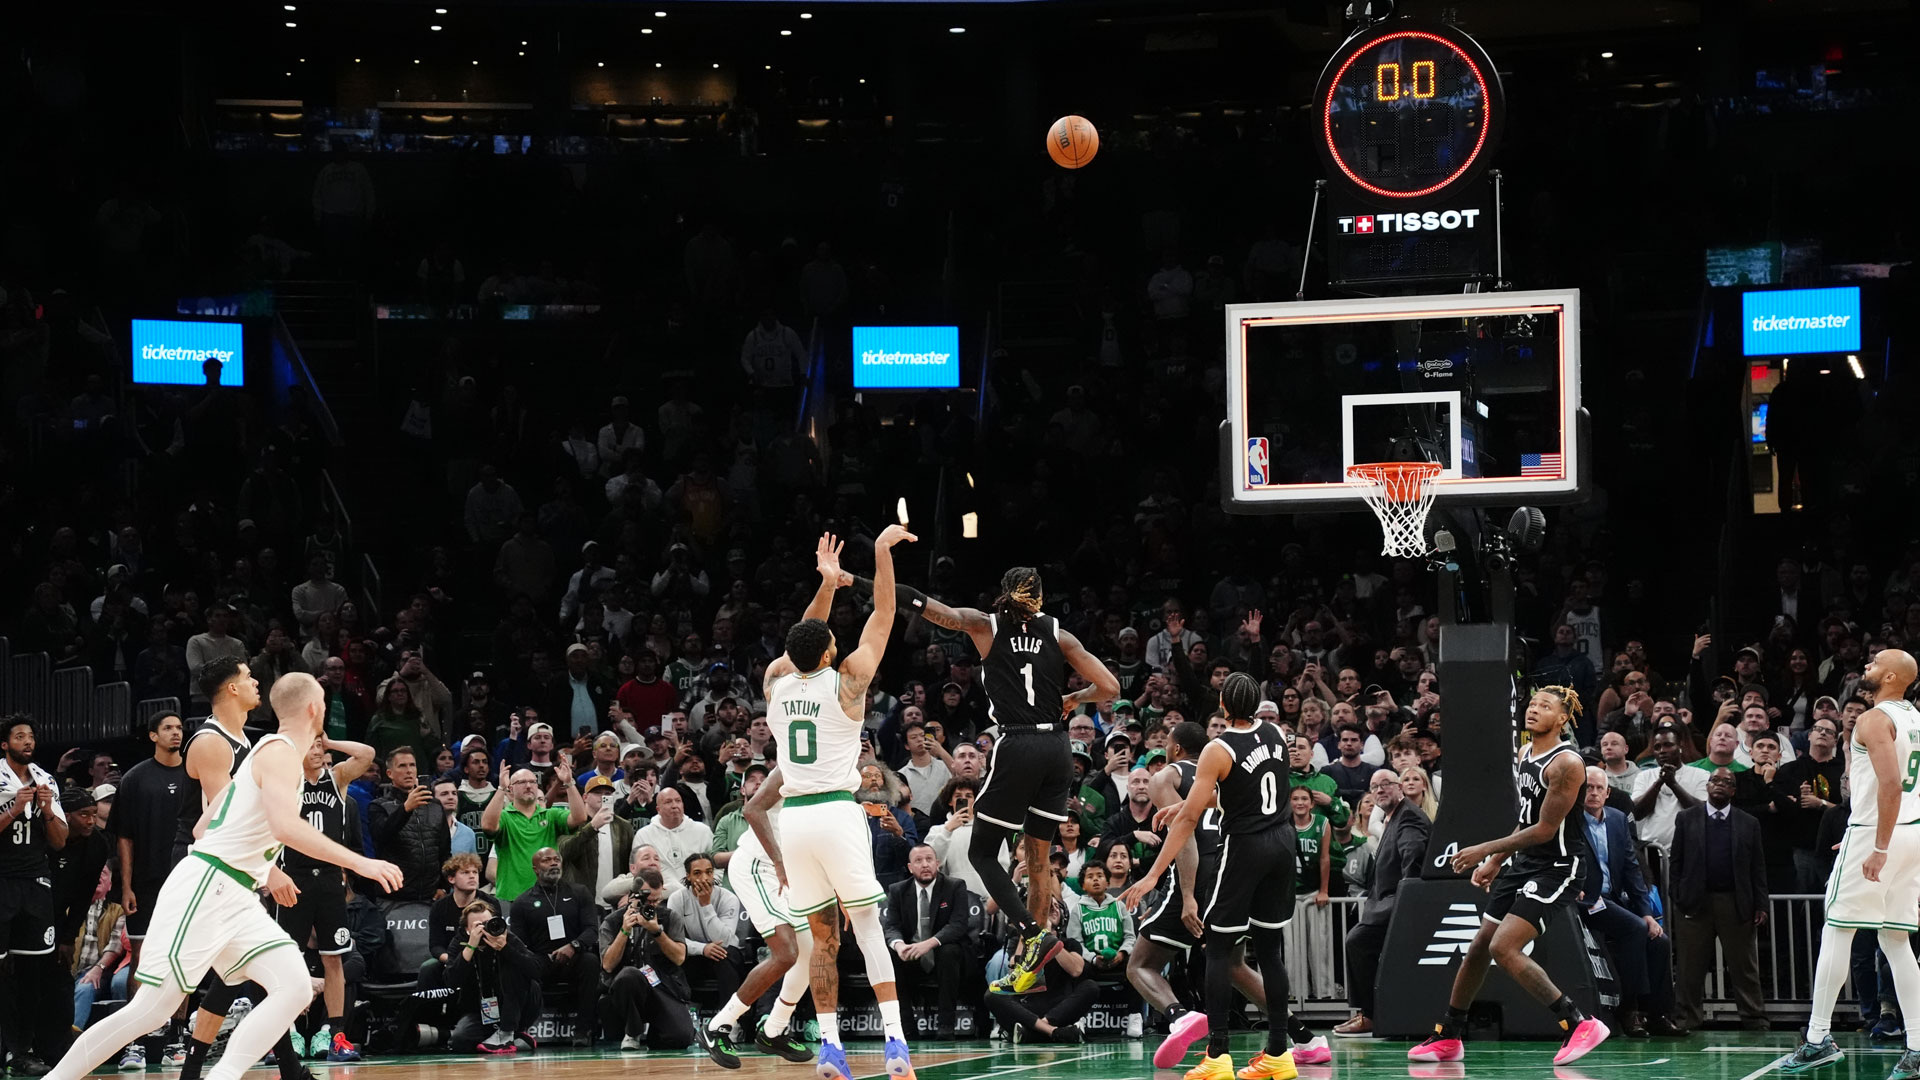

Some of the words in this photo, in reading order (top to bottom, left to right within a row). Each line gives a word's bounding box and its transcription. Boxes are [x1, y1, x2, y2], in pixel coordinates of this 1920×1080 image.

[1377, 60, 1435, 101] 0.0
[1376, 208, 1480, 233] TISSOT
[1752, 314, 1850, 332] ticketmaster
[141, 344, 234, 363] ticketmaster
[862, 349, 950, 366] ticketmaster
[1010, 636, 1043, 654] ELLIS
[1020, 663, 1035, 706] 1
[782, 700, 820, 718] TATUM
[788, 720, 817, 764] 0
[1241, 744, 1271, 774] BROWN
[1273, 744, 1283, 762] JR.
[1902, 750, 1920, 792] 9
[1260, 771, 1277, 815] 0
[1519, 796, 1531, 824] 21
[306, 810, 324, 833] 10
[13, 820, 31, 845] 31
[1300, 838, 1318, 853] TICS
[386, 919, 428, 930] PIMC
[1083, 916, 1118, 936] BOSTON
[1094, 934, 1109, 952] 0
[528, 1021, 576, 1038] etBlu
[837, 1014, 884, 1031] jetBlu
[1086, 1011, 1129, 1029] tBlue
